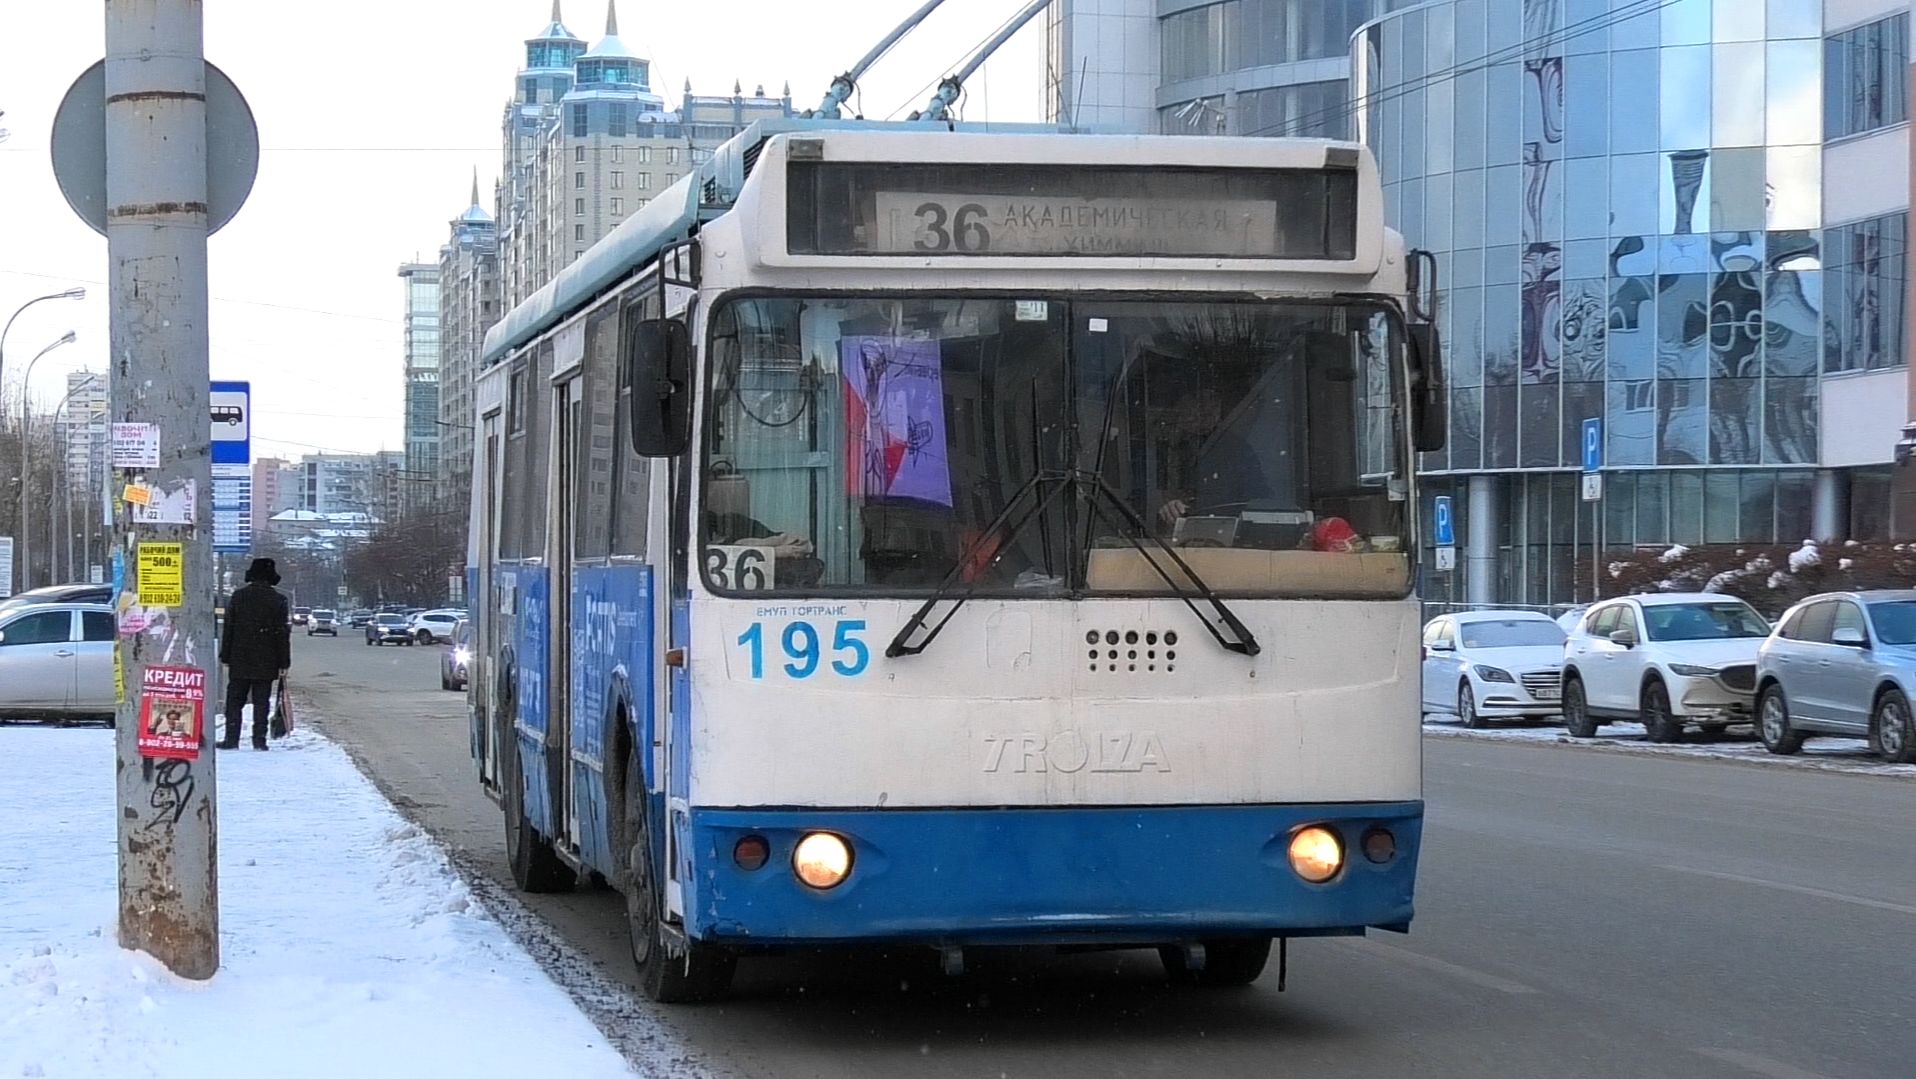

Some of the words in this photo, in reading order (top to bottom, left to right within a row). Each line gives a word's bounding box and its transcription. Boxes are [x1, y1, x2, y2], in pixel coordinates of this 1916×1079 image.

[913, 201, 990, 251] 36
[1588, 427, 1597, 465] P
[1438, 503, 1448, 538] P
[152, 556, 171, 567] 500
[706, 548, 766, 590] 36
[757, 607, 787, 617] ЕМУП
[792, 606, 848, 616] ГОРТРАНС
[737, 620, 869, 679] 195
[144, 669, 204, 688] КРЕДИТ
[984, 731, 1172, 773] TROLZA
